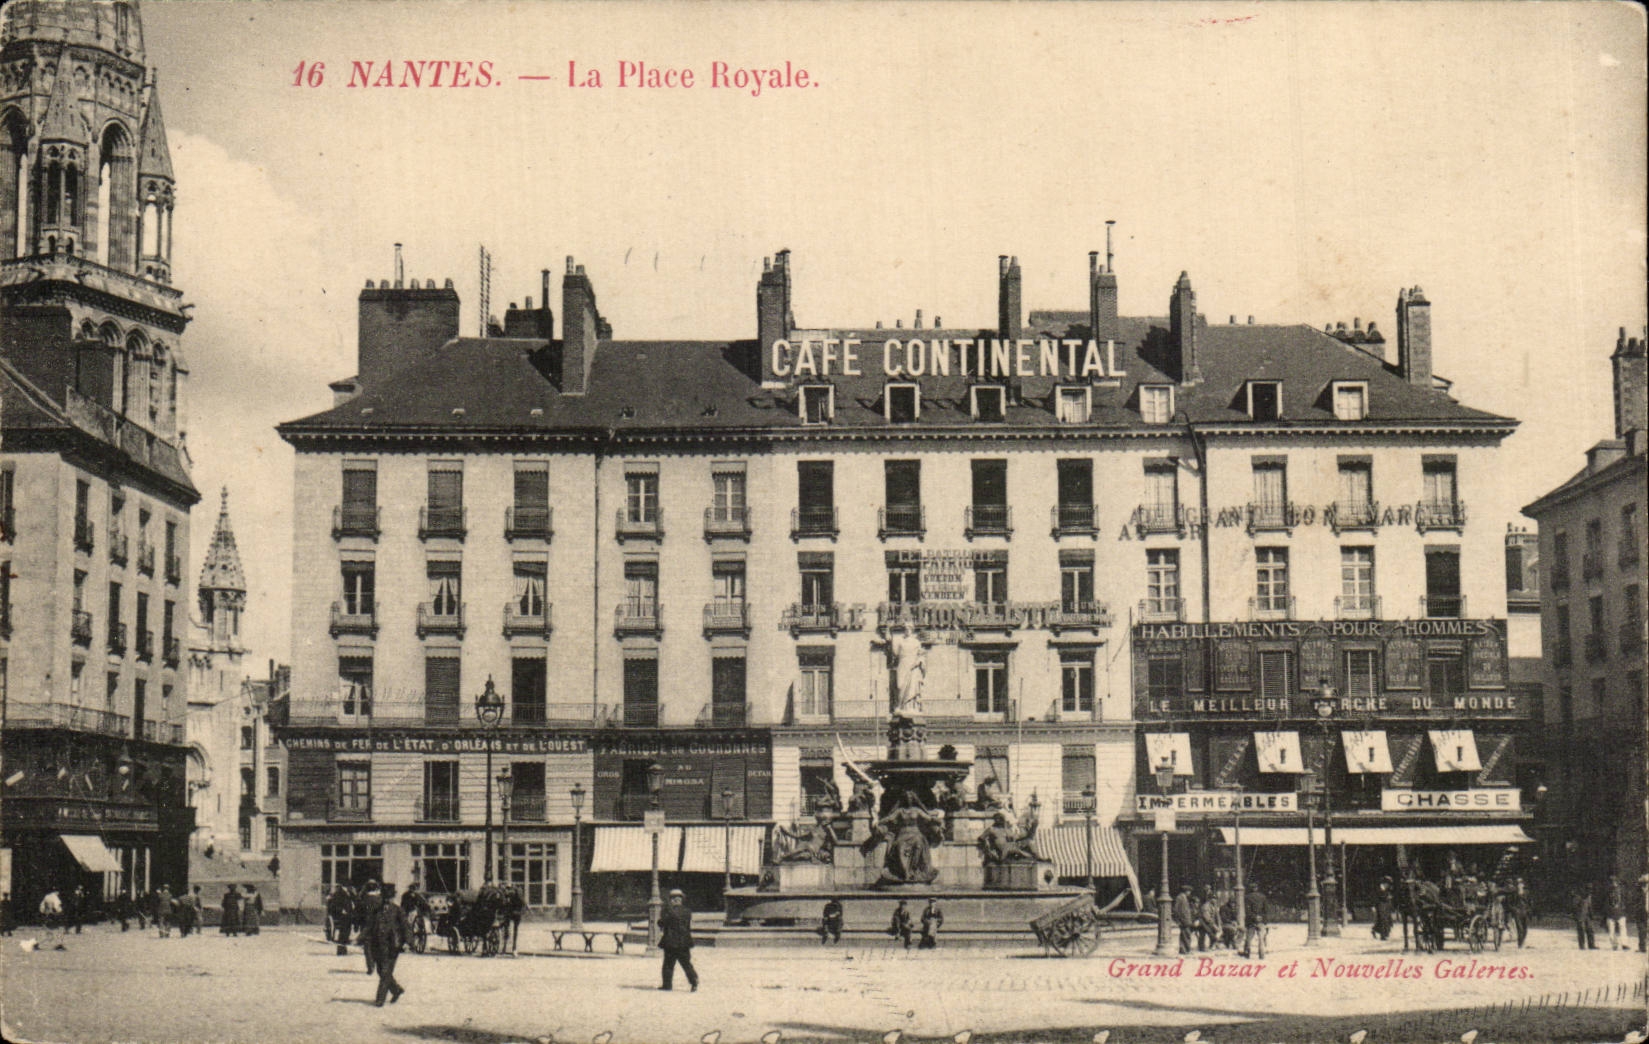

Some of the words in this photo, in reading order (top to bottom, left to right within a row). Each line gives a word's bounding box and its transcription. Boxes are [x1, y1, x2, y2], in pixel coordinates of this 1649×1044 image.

[771, 332, 862, 376] CAFÉ
[883, 338, 1126, 377] CONTINENTAL
[1141, 622, 1300, 639] HABILLEMENTS
[1332, 621, 1380, 636] POUR
[1406, 620, 1488, 636] HOMMES
[1150, 700, 1170, 713] LE
[1193, 698, 1290, 712] MEILLEUR
[1411, 697, 1433, 710] DU
[1454, 696, 1517, 711] MONDE
[285, 738, 331, 750] CHEMINS
[352, 739, 372, 750] FER
[539, 740, 585, 751] L'OUEST
[1397, 793, 1510, 806] CHASSE
